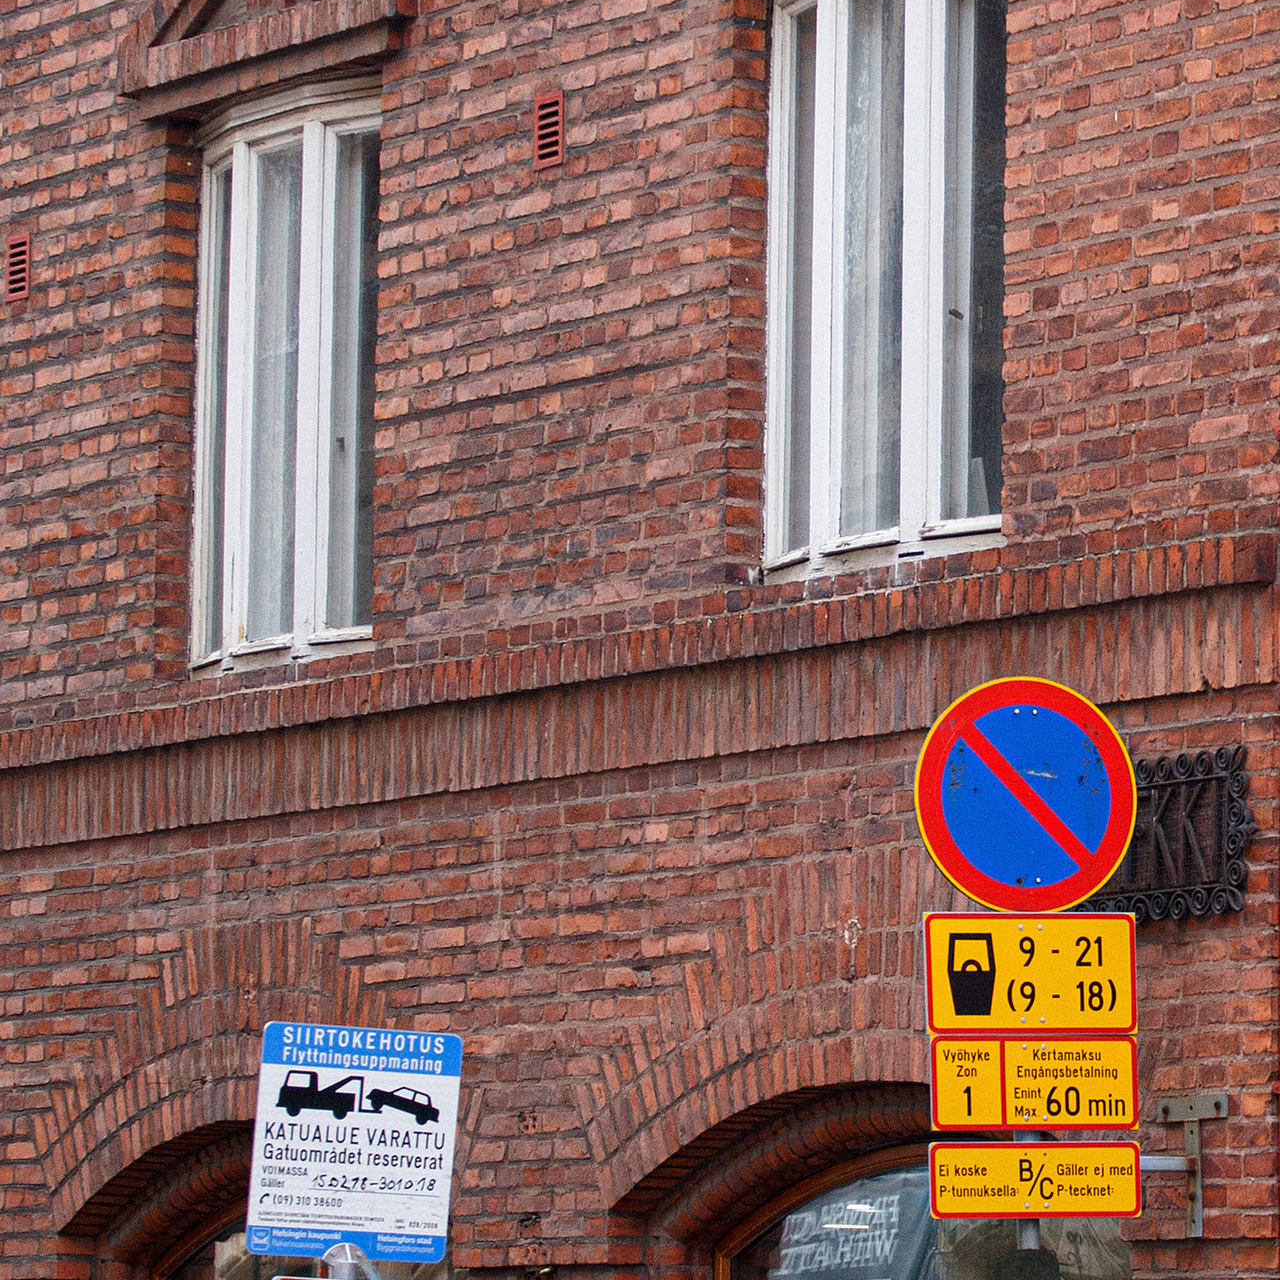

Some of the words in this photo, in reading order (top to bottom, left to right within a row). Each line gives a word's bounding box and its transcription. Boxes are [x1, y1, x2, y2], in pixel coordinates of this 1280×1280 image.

[1019, 936, 1035, 967] 9
[1075, 936, 1103, 967] 21
[1007, 979, 1036, 1012] (9
[1076, 979, 1117, 1012] 18)
[282, 1026, 445, 1055] SIIRTOKEHOTUS
[282, 1046, 443, 1075] Flyttningsuppmaning
[942, 1048, 990, 1063] Vyöhyke
[1032, 1049, 1101, 1061] Kertamaksu
[956, 1065, 977, 1078] Zon
[1016, 1065, 1118, 1080] Engångsbetalning
[963, 1086, 972, 1116] 1
[1046, 1086, 1081, 1117] 60
[1088, 1094, 1126, 1117] min
[264, 1121, 360, 1145] KATUALUE
[366, 1128, 446, 1150] VARATTU
[263, 1143, 362, 1166] Gatuområdet
[367, 1152, 443, 1171] reserverat
[261, 1165, 308, 1177] VOIMASSA
[939, 1164, 949, 1176] Ei
[954, 1164, 987, 1176] koske
[1056, 1164, 1088, 1176] Gäller
[1094, 1164, 1105, 1178] ej
[1109, 1164, 1133, 1176] med
[260, 1177, 286, 1189] Gäller
[1056, 1184, 1114, 1197] P-tecknet:
[939, 1185, 1019, 1198] P-tunnuksella:
[272, 1193, 294, 1206] (09)
[296, 1195, 311, 1206] 310
[313, 1196, 343, 1208] 38600
[272, 1228, 306, 1239] Helsingin
[307, 1230, 342, 1240] kaupunki
[377, 1234, 415, 1245] Helsingfors
[417, 1236, 432, 1245] stad
